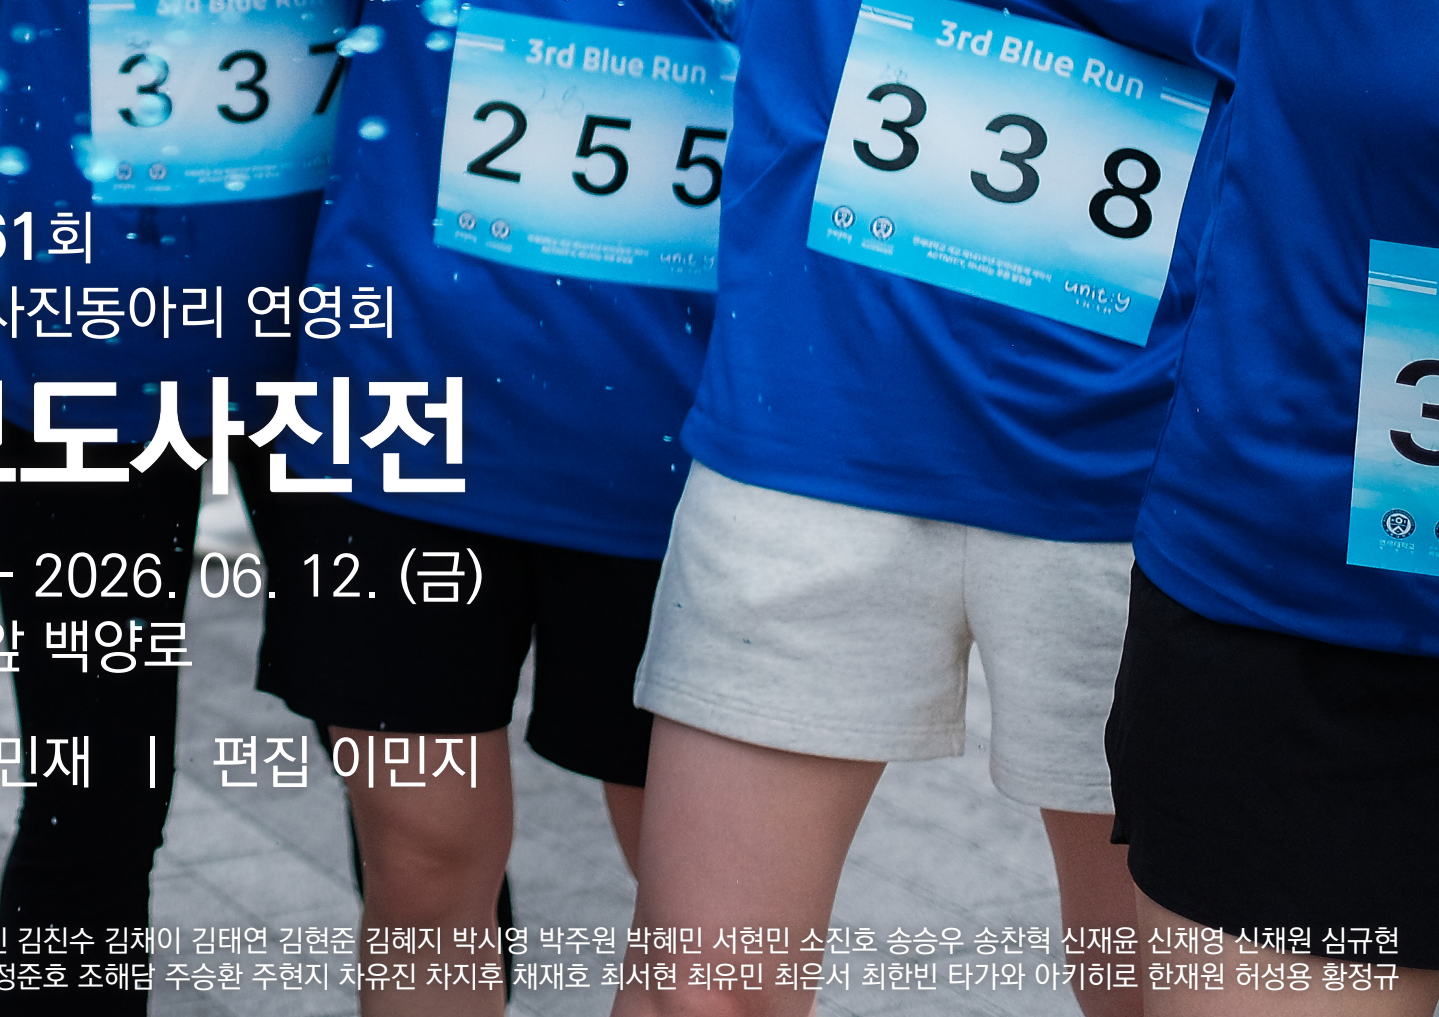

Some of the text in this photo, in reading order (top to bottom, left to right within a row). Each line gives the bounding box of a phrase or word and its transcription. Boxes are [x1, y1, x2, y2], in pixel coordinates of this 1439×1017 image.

[526, 38, 706, 84] 3rd Blue Run
[936, 19, 1144, 100] 3rd Blue Run
